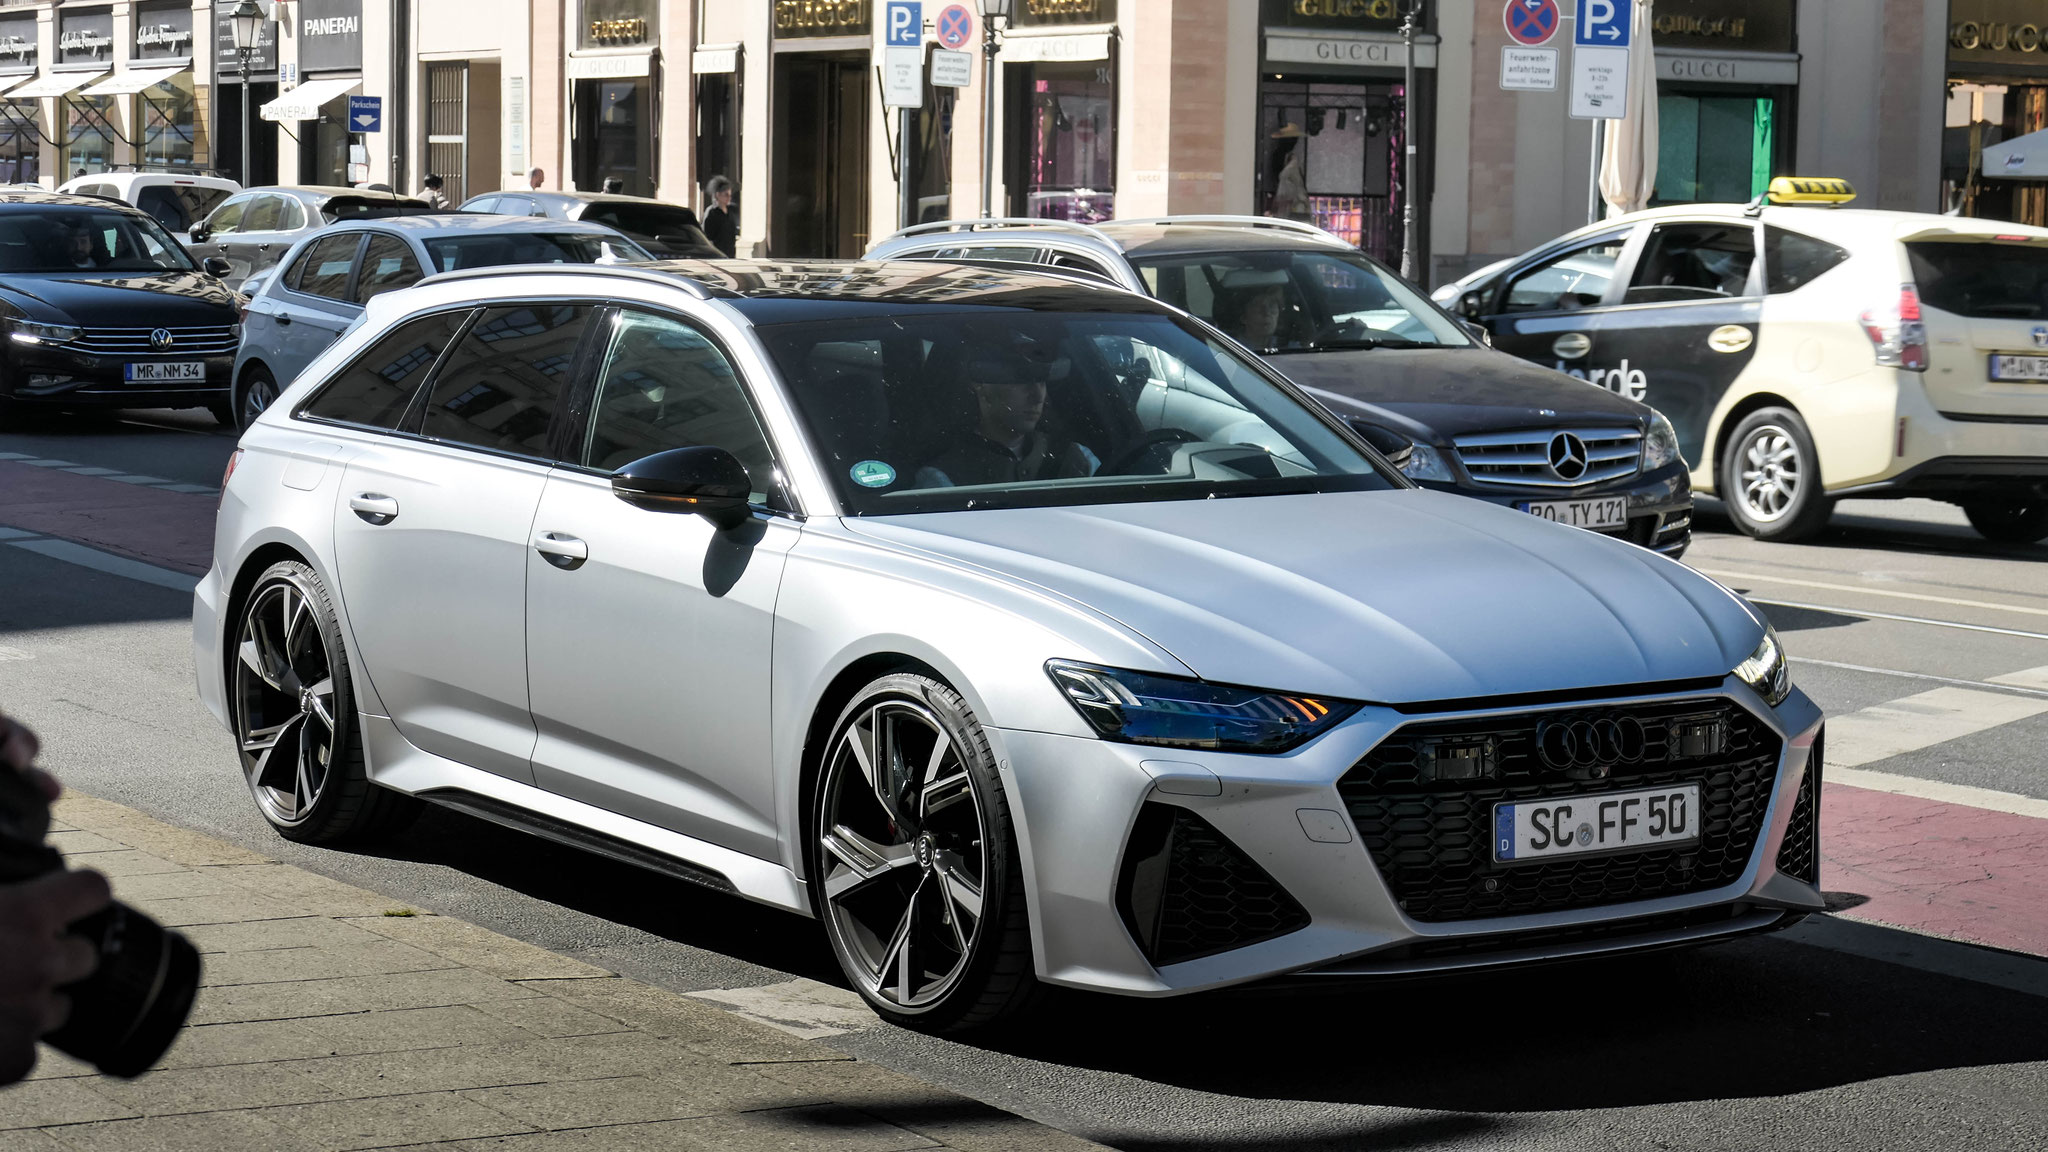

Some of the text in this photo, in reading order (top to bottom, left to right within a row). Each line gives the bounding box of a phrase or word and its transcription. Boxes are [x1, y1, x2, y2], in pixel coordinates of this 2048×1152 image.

[304, 16, 358, 36] PANERAI
[891, 6, 911, 41] P
[1584, 0, 1615, 39] P
[1950, 21, 2048, 53] GUC
[1316, 43, 1388, 62] GUCCI
[1671, 60, 1736, 79] GUCCI
[351, 101, 380, 109] Parkschein
[137, 364, 199, 379] MR NM 34
[1569, 502, 1591, 525] TY
[1596, 500, 1625, 523] 171
[1530, 793, 1686, 850] SC FF 50
[1501, 839, 1509, 851] D
